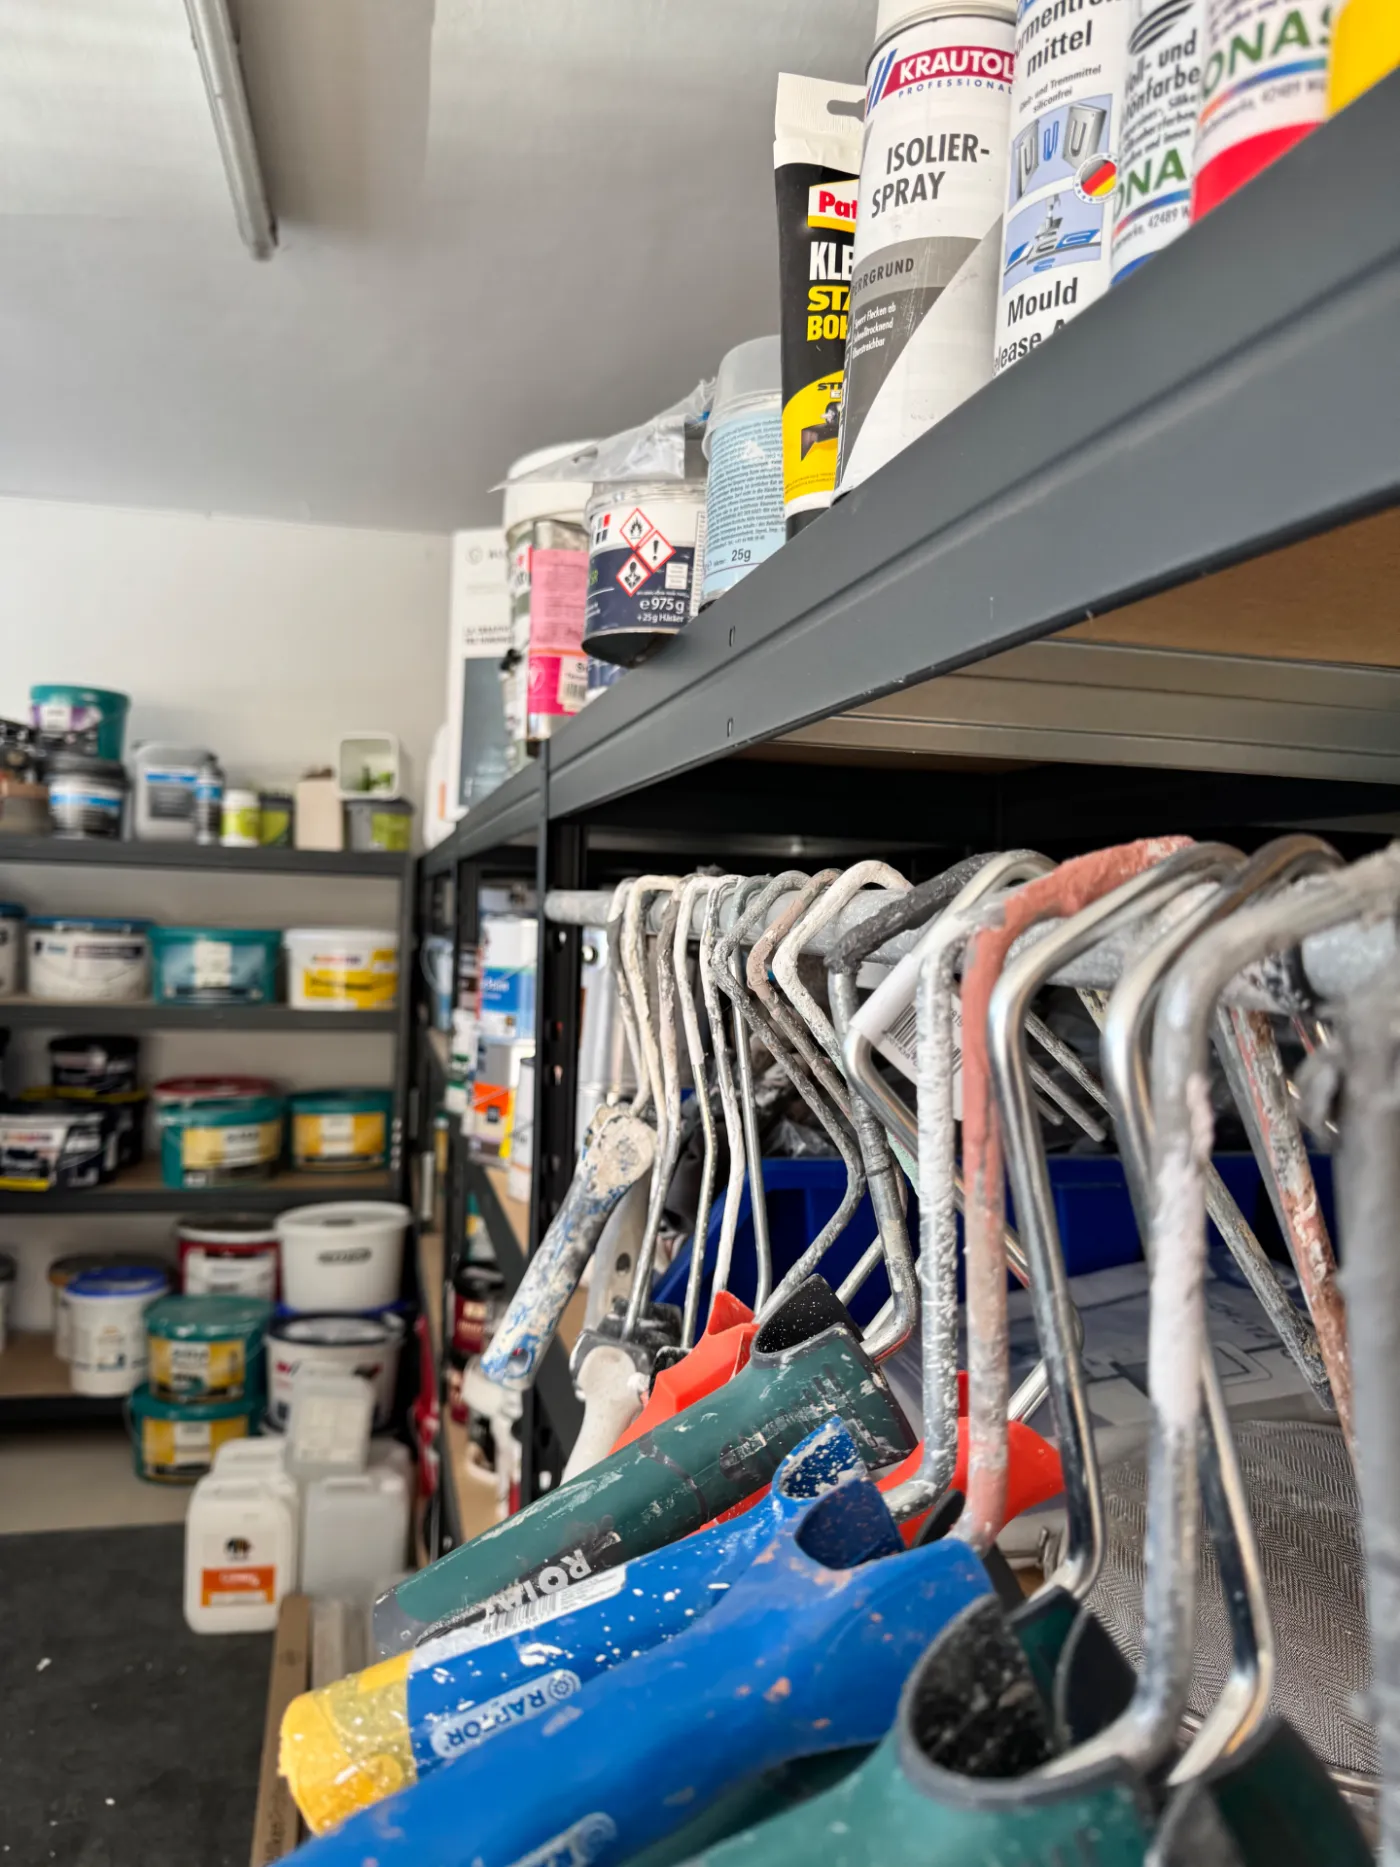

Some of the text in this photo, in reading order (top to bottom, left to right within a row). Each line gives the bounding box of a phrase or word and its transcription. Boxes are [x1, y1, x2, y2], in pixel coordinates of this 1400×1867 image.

[898, 49, 1015, 84] KRAUTOL
[1027, 19, 1093, 78] mittel
[1158, 28, 1197, 68] und
[898, 77, 1013, 99] PROFESSIONAL
[886, 133, 990, 175] ISOLIER-
[871, 170, 946, 218] SPRAY
[1007, 276, 1078, 328] Mould
[731, 548, 752, 563] 25g
